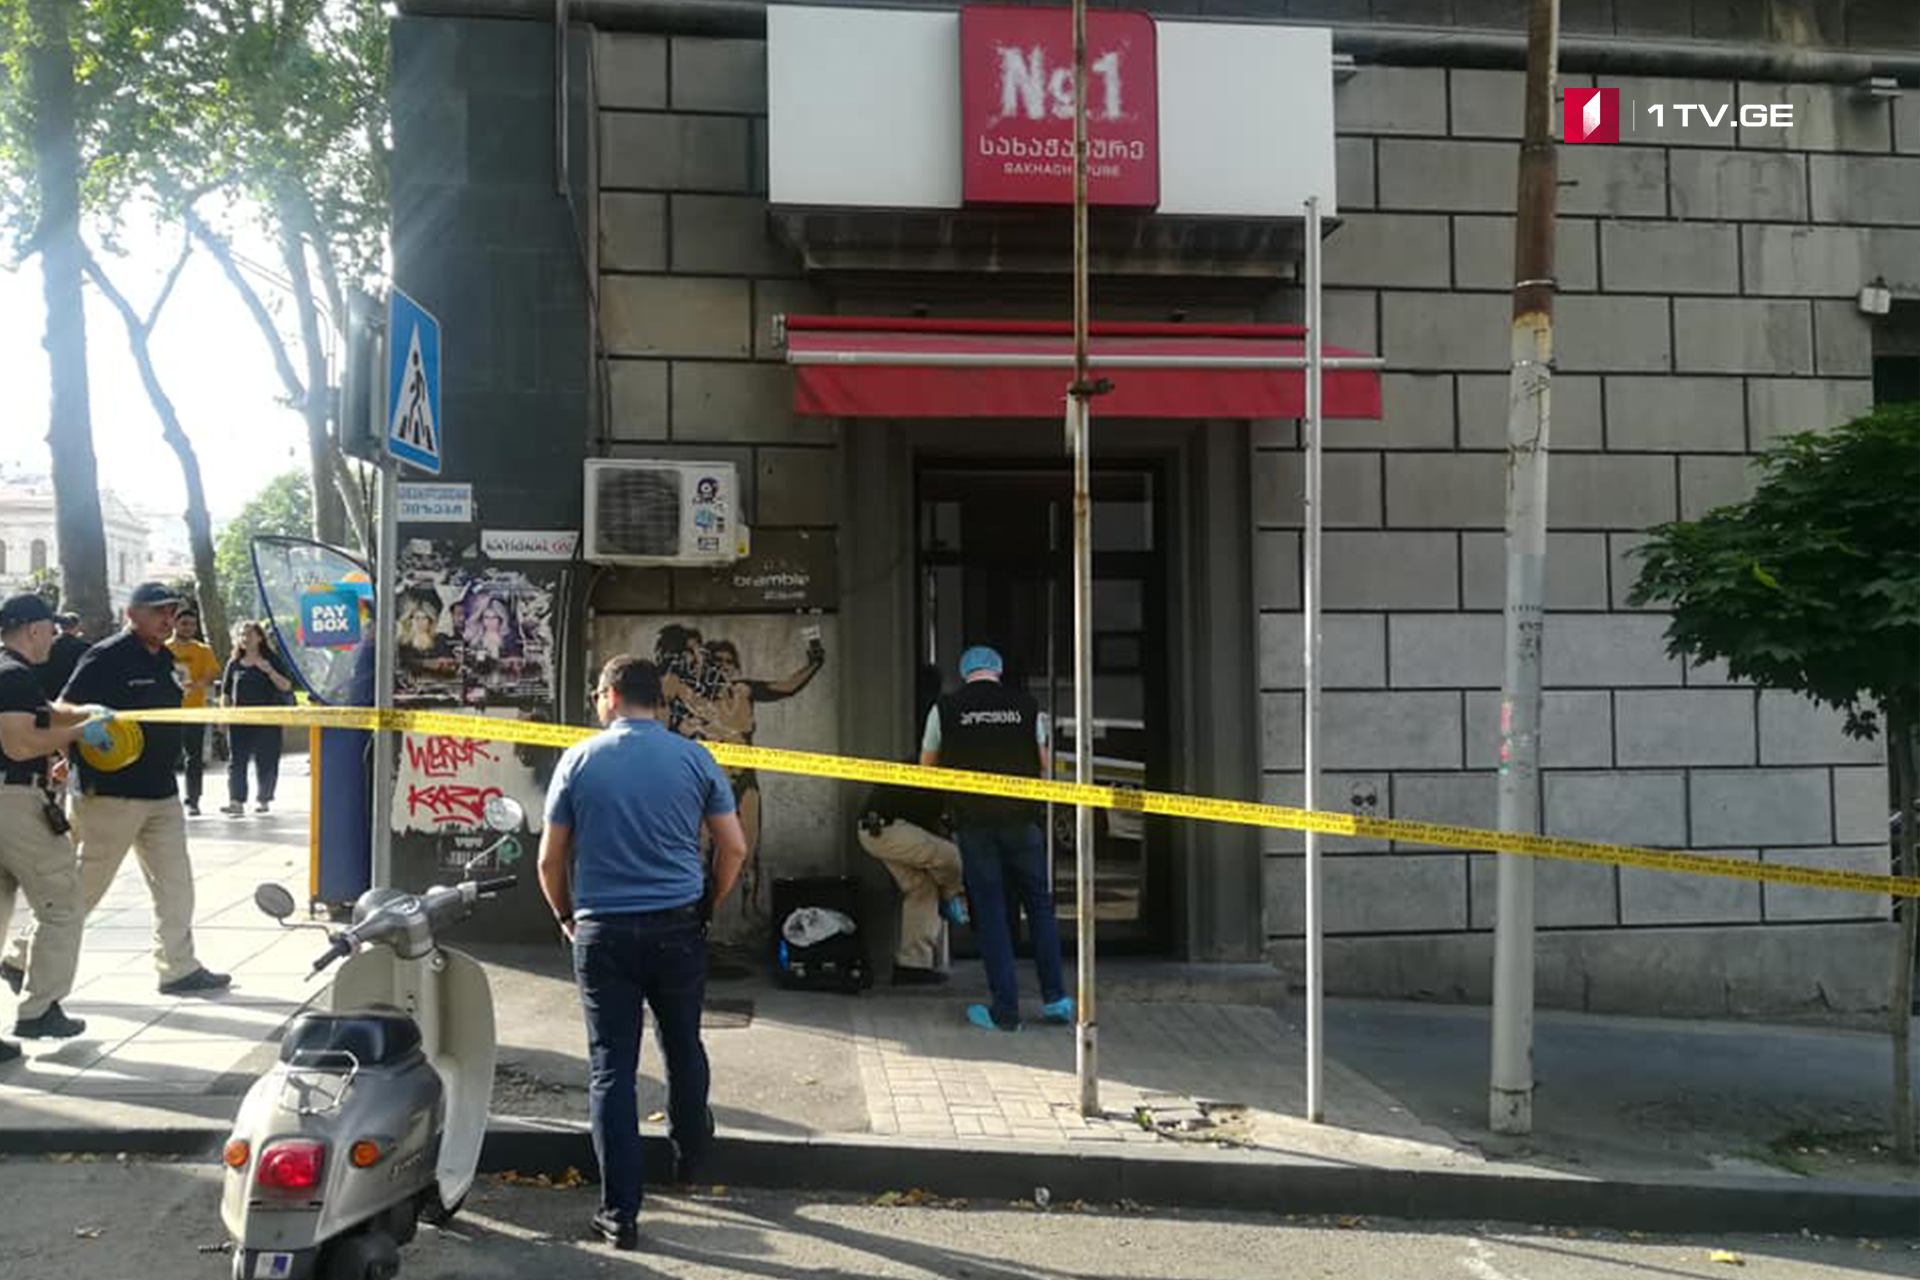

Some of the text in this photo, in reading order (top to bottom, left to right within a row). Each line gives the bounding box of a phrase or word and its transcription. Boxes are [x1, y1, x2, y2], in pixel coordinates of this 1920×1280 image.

[980, 135, 1145, 160] სახაჭაურე
[311, 604, 346, 619] PAY
[312, 618, 349, 632] BOX
